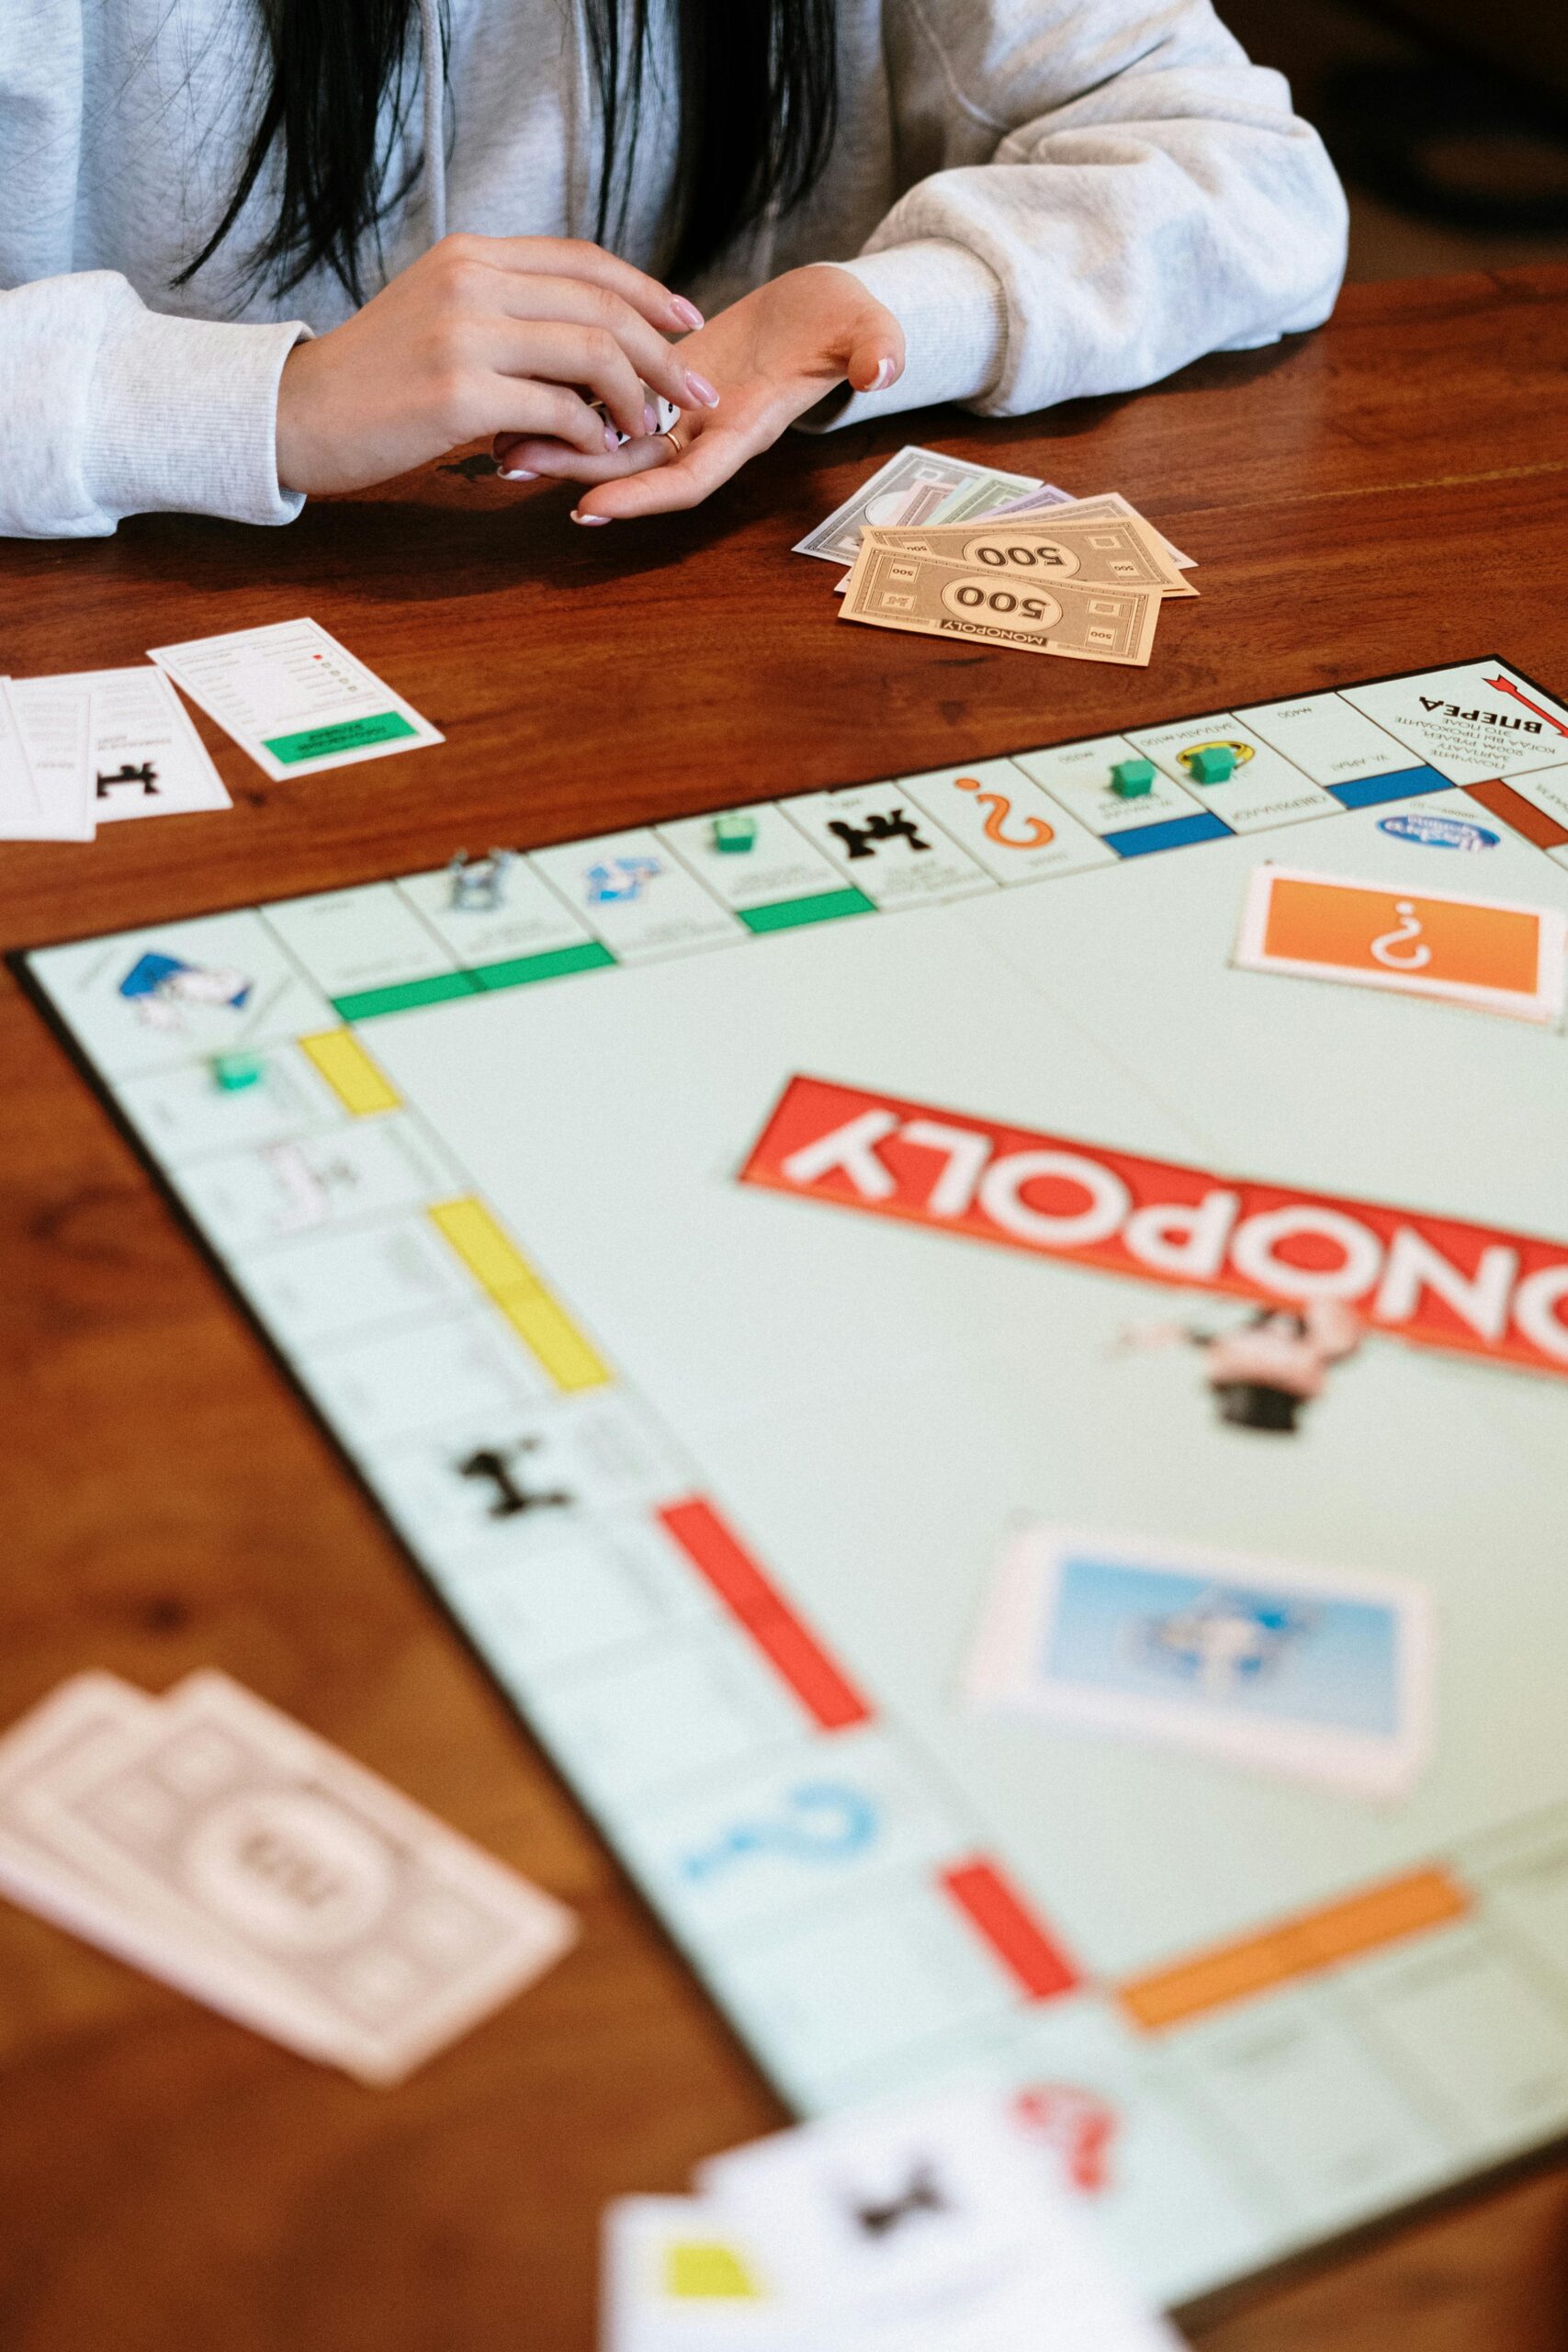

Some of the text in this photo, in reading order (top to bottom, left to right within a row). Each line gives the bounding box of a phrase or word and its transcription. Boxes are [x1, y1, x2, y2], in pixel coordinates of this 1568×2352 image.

[975, 547, 1066, 568] 500
[892, 569, 914, 577] 500
[953, 586, 1050, 621] 500
[942, 620, 1043, 645] MONOPOLY
[1090, 630, 1112, 640] 500
[1419, 696, 1542, 734] ВПЕРЕД
[1395, 717, 1555, 754] КОГДА ВЫ ПРОХОДИТЕ
[1442, 718, 1512, 737] ЭТО ПОЛЕ
[1430, 749, 1506, 770] ПОЛУЧИТЕ
[1438, 742, 1509, 763] ЗАРПЛАТУ
